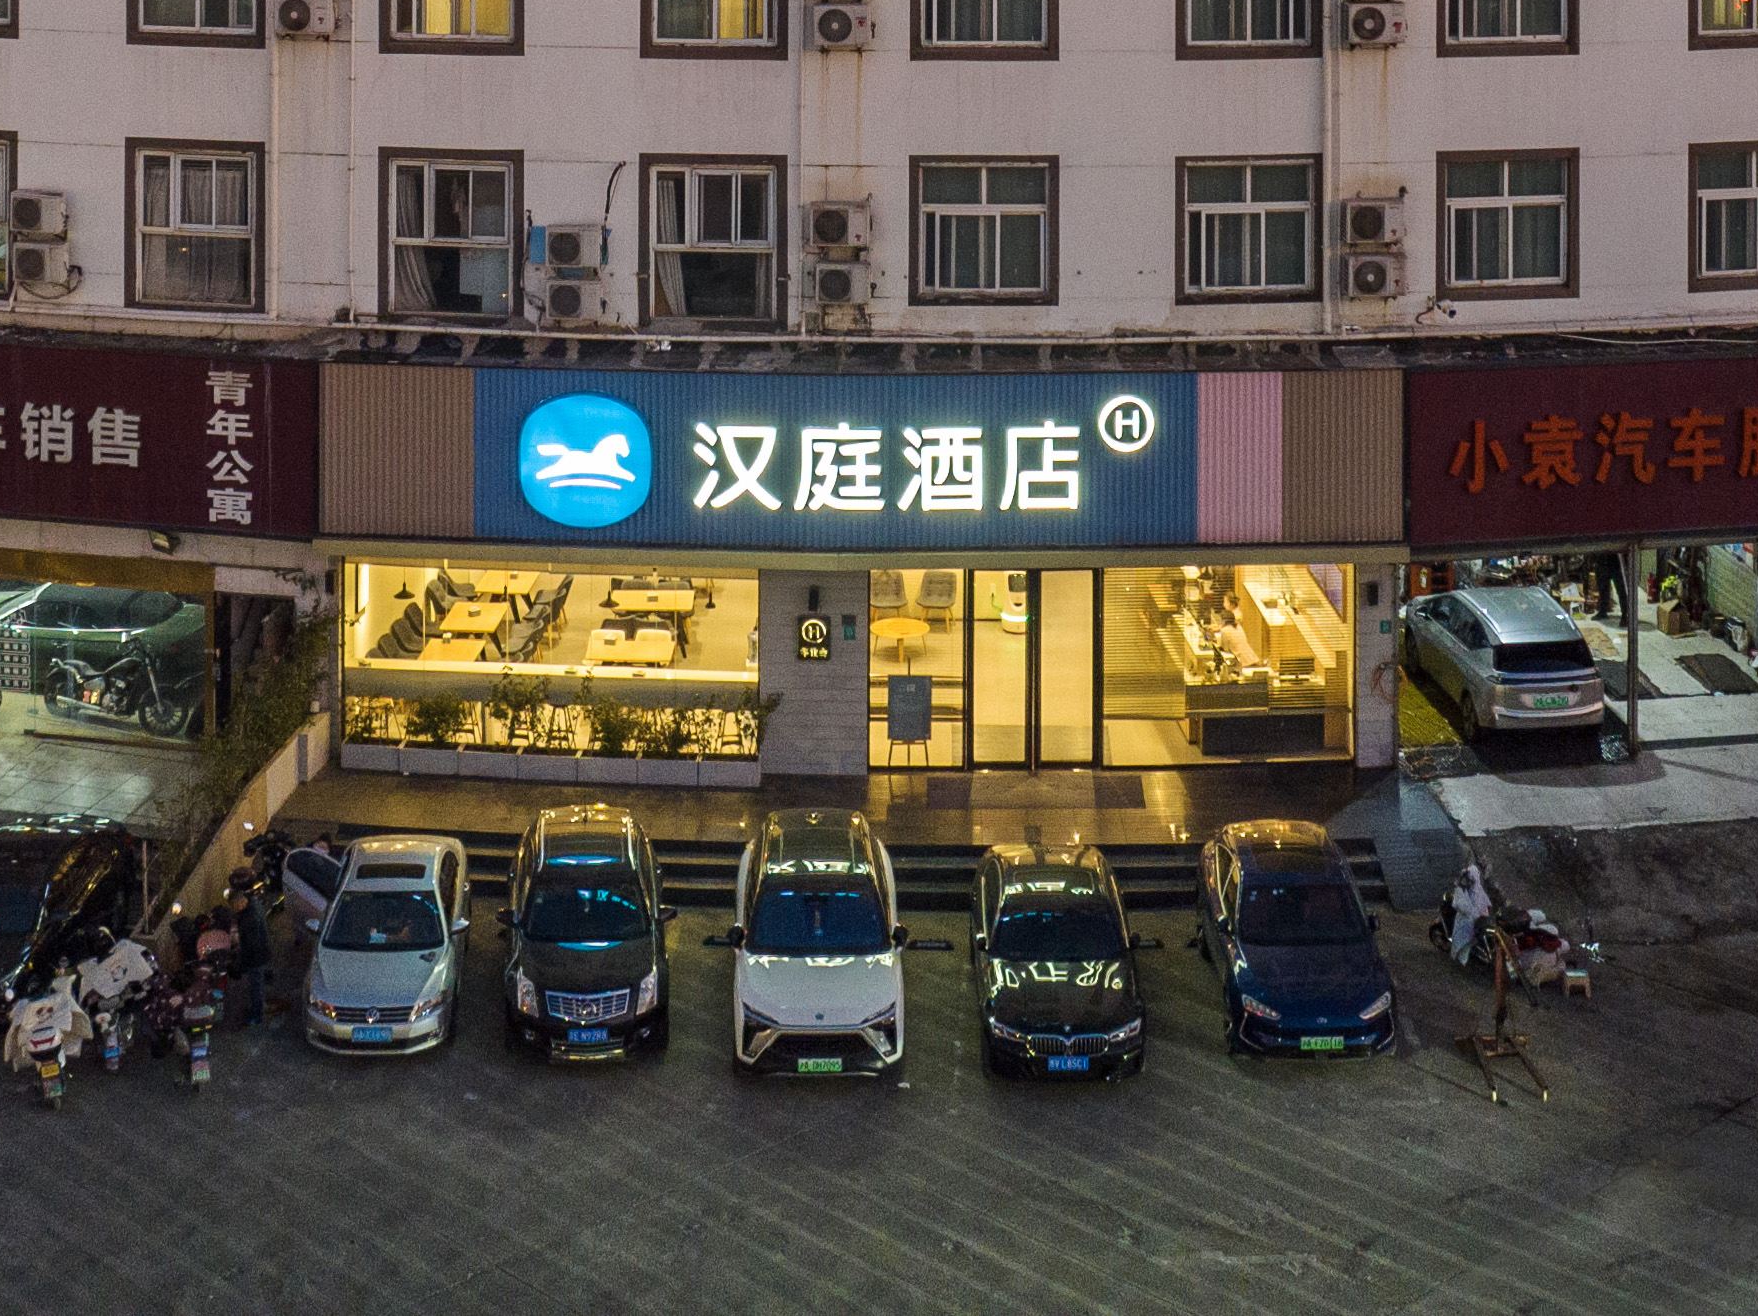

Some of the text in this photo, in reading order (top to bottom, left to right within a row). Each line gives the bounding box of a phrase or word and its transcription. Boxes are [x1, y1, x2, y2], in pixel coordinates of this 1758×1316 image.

[205, 370, 254, 527] 青年公寓
[692, 420, 1082, 512] 汉庭酒店
